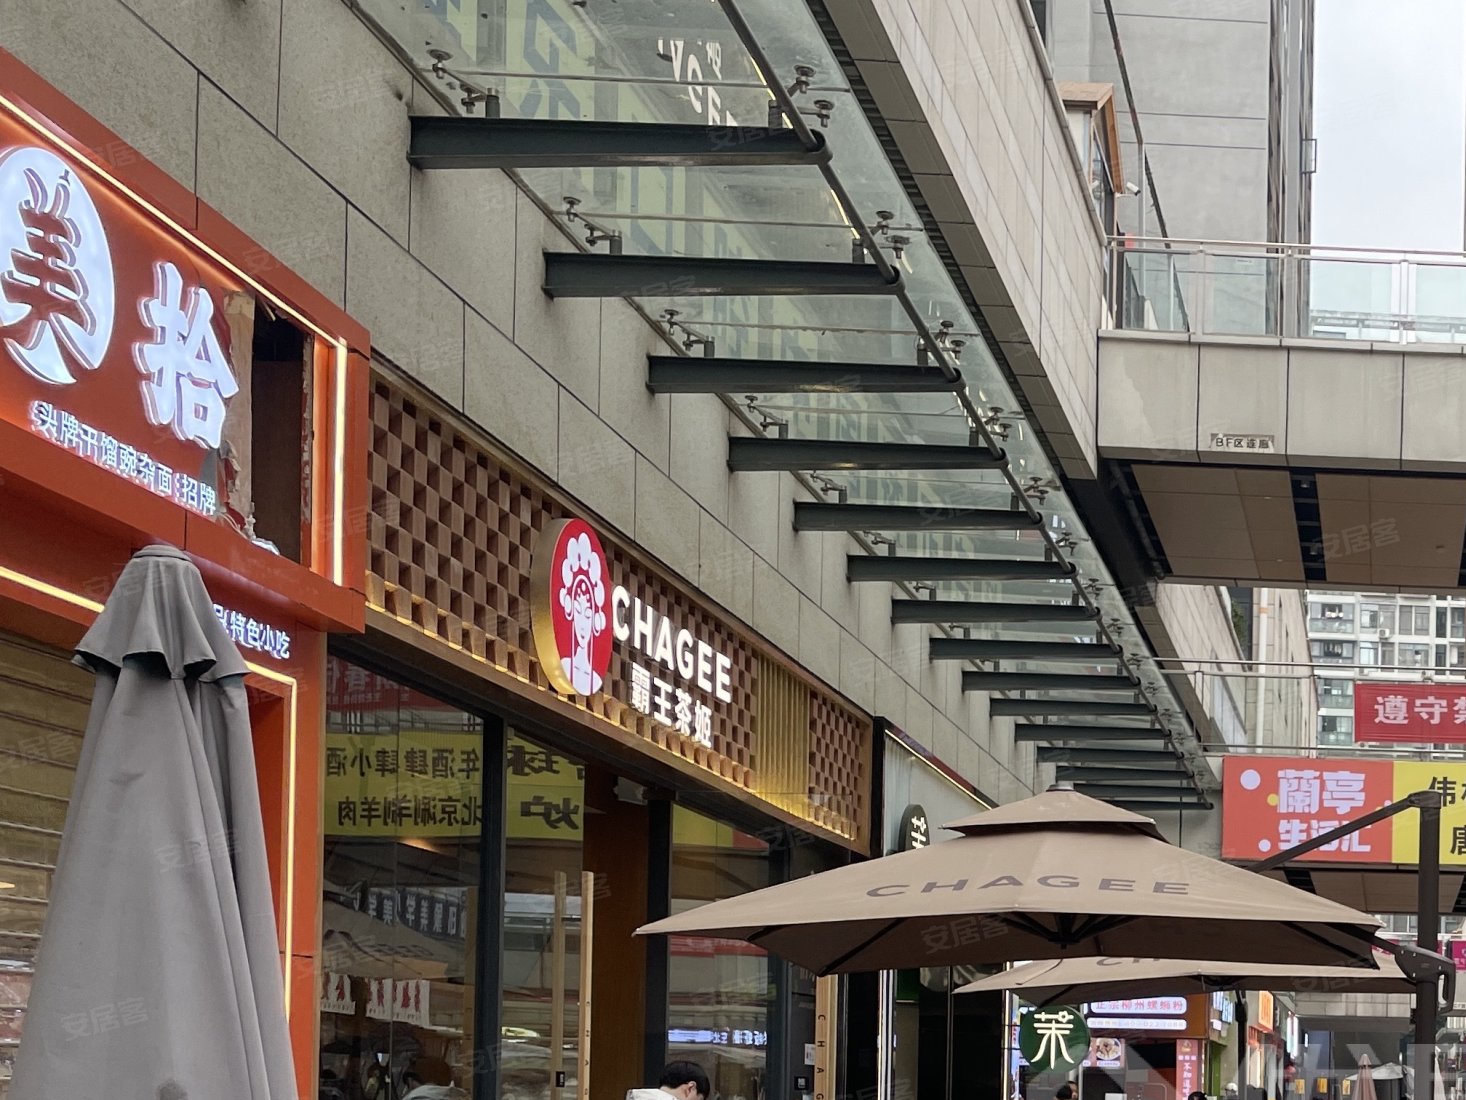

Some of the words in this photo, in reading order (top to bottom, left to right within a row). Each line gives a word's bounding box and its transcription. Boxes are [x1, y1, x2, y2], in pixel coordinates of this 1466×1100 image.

[611, 585, 732, 703] CHAGEE
[631, 662, 712, 748] 霸王茶姬
[1277, 768, 1366, 815] 蘭亭
[866, 873, 1191, 899] CHAGEE
